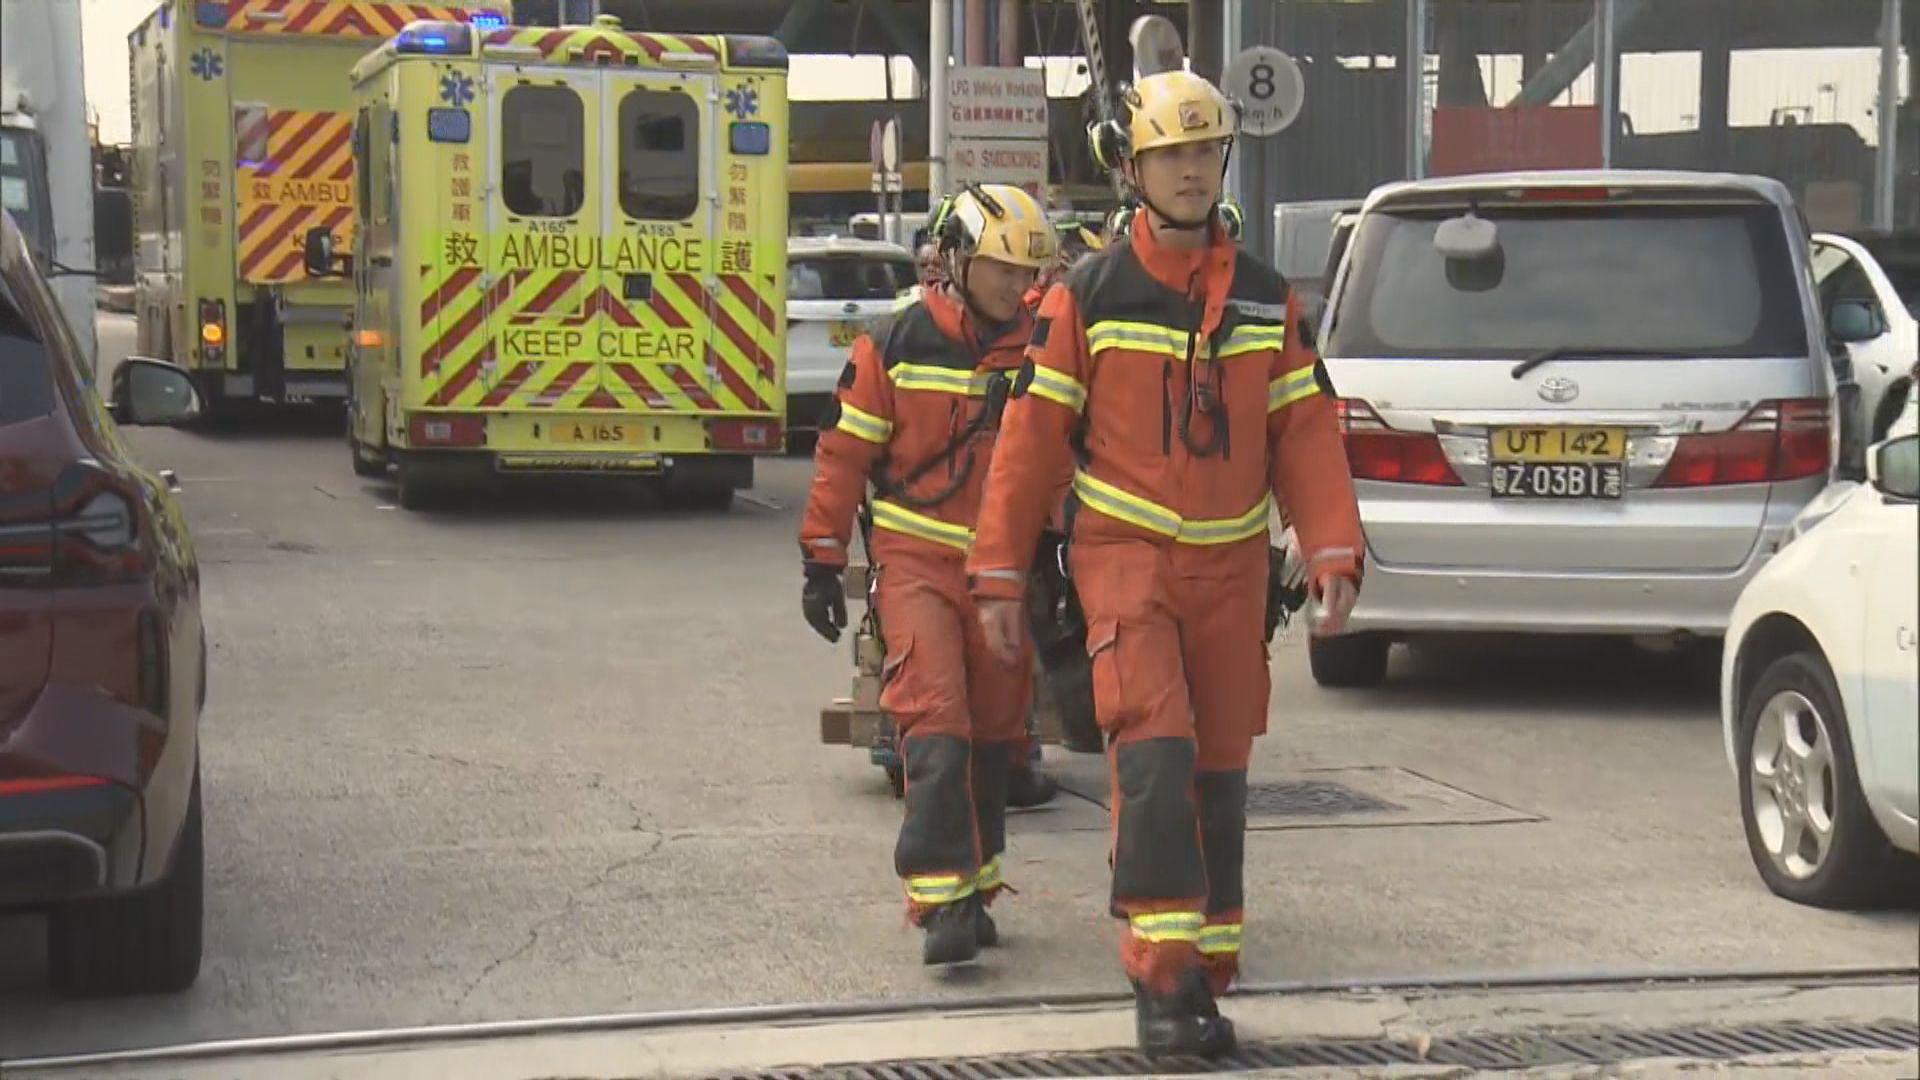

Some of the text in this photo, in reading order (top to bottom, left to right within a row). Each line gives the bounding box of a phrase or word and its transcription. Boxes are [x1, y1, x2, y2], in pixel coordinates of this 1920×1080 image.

[1249, 64, 1275, 99] 8
[280, 182, 350, 202] AMBU
[445, 231, 478, 265] 救
[501, 235, 703, 271] AMBULANCE
[503, 329, 695, 360] KEEP CLEAR
[573, 424, 625, 441] A 165
[1506, 429, 1610, 455] UT 142
